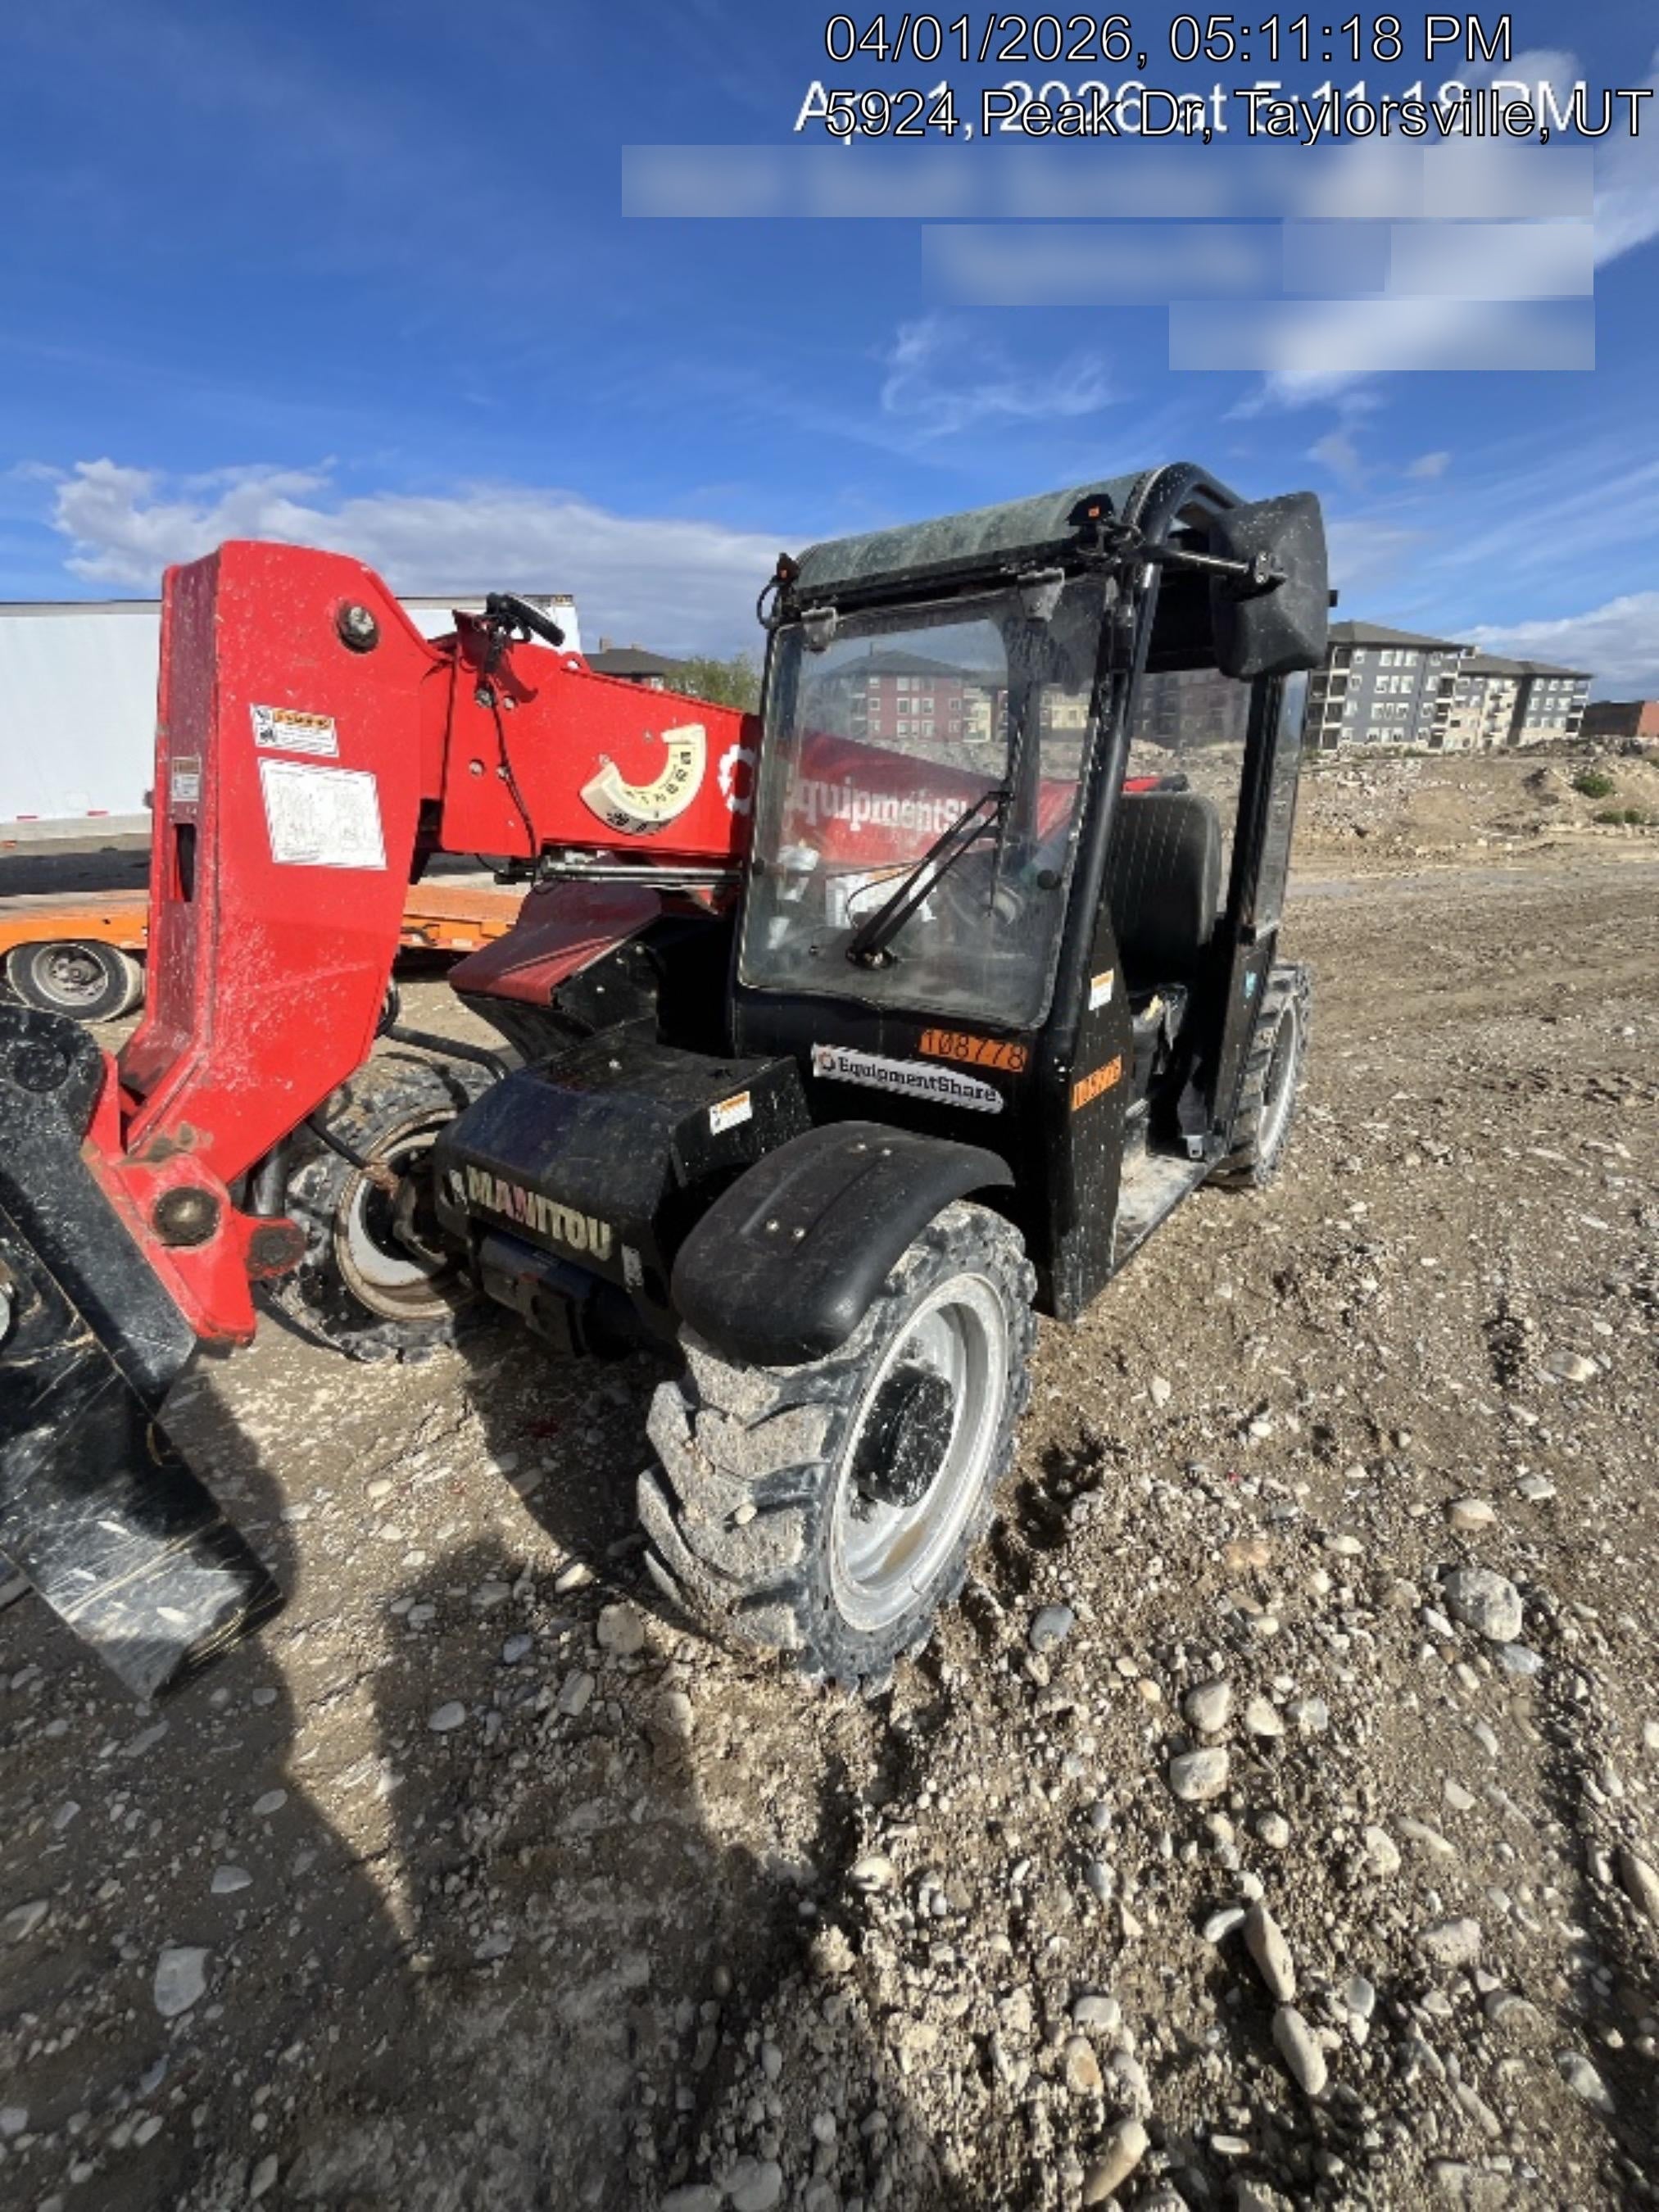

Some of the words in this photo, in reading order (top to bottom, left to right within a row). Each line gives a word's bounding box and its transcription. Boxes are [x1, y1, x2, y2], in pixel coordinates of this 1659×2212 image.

[924, 1028, 1025, 1071] 108778
[836, 1056, 997, 1103] EquipmentShare
[465, 1164, 613, 1262] MANITOU
